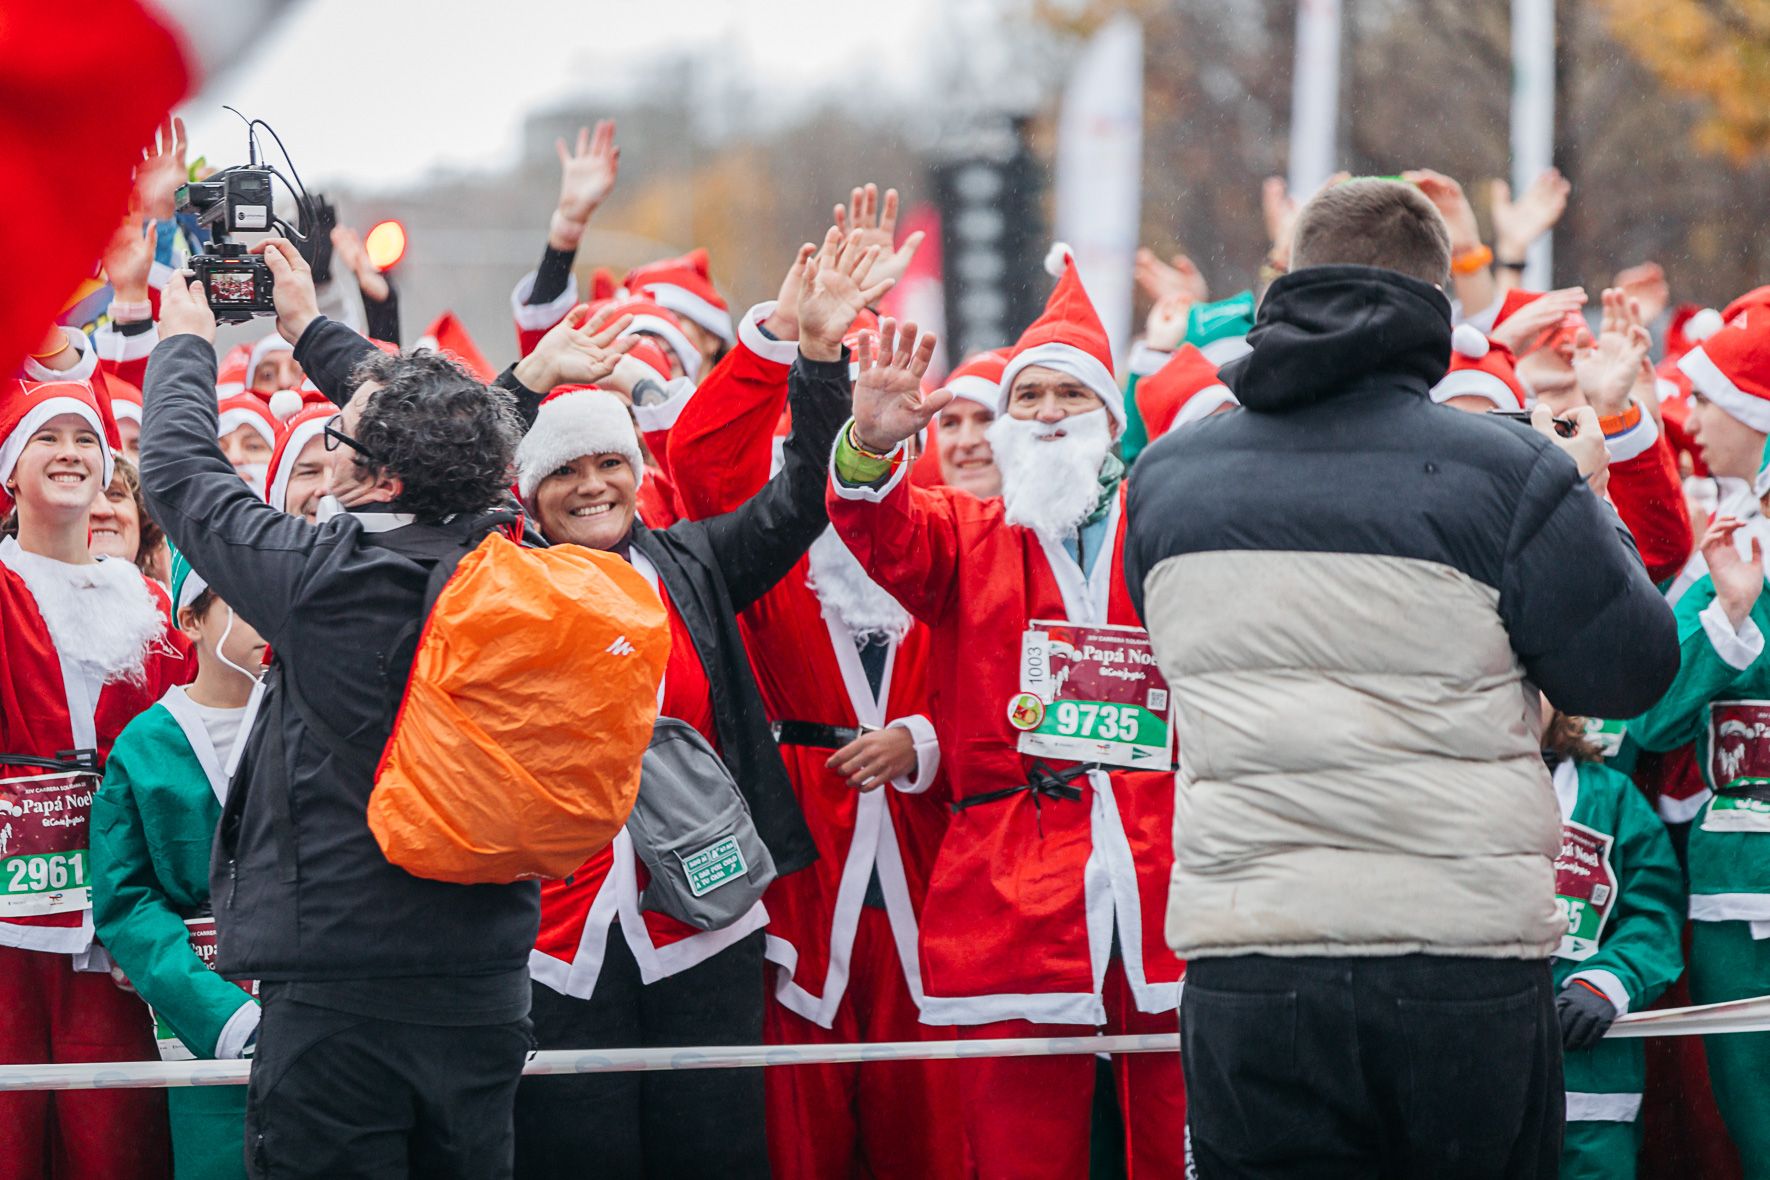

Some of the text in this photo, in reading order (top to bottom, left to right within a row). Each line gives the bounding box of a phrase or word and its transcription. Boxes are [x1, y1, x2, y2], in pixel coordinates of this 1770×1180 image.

[1027, 647, 1044, 685] 1003
[1082, 645, 1159, 666] Papá Noe
[1056, 702, 1140, 742] 9735
[21, 790, 93, 817] Papá Noel
[1574, 844, 1599, 868] Noel
[6, 853, 84, 893] 2961
